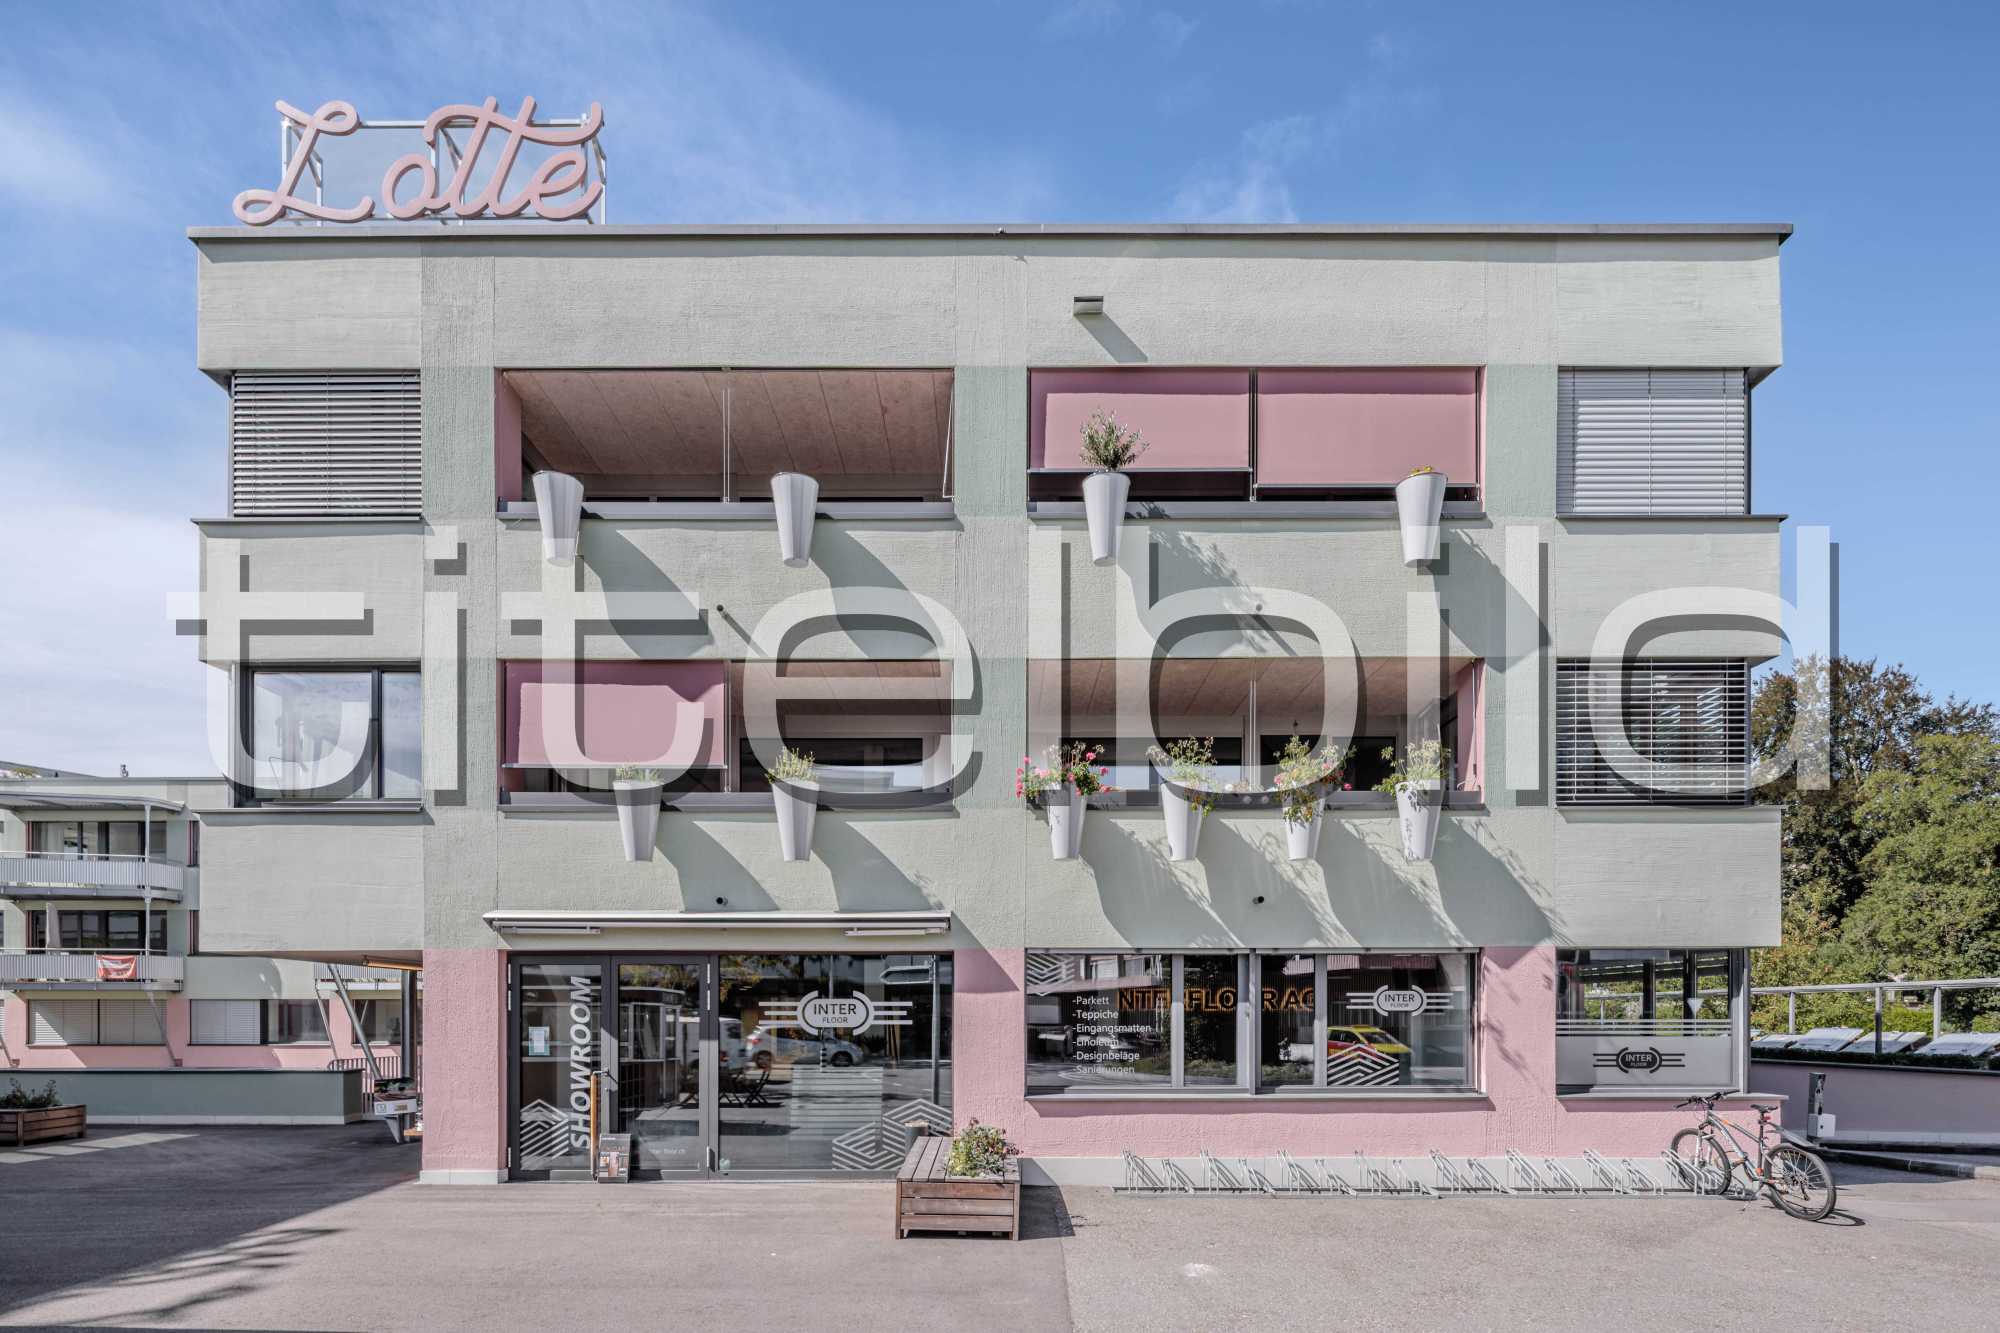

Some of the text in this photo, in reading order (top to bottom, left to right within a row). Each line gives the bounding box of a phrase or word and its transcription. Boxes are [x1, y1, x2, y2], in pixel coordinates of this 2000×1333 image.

[232, 95, 603, 226] Lotte
[1384, 993, 1415, 1003] INTER
[813, 1003, 857, 1015] INTER
[822, 1016, 849, 1024] FLOOR
[570, 975, 592, 1150] SHOWROOM
[1625, 1054, 1653, 1062] INTER
